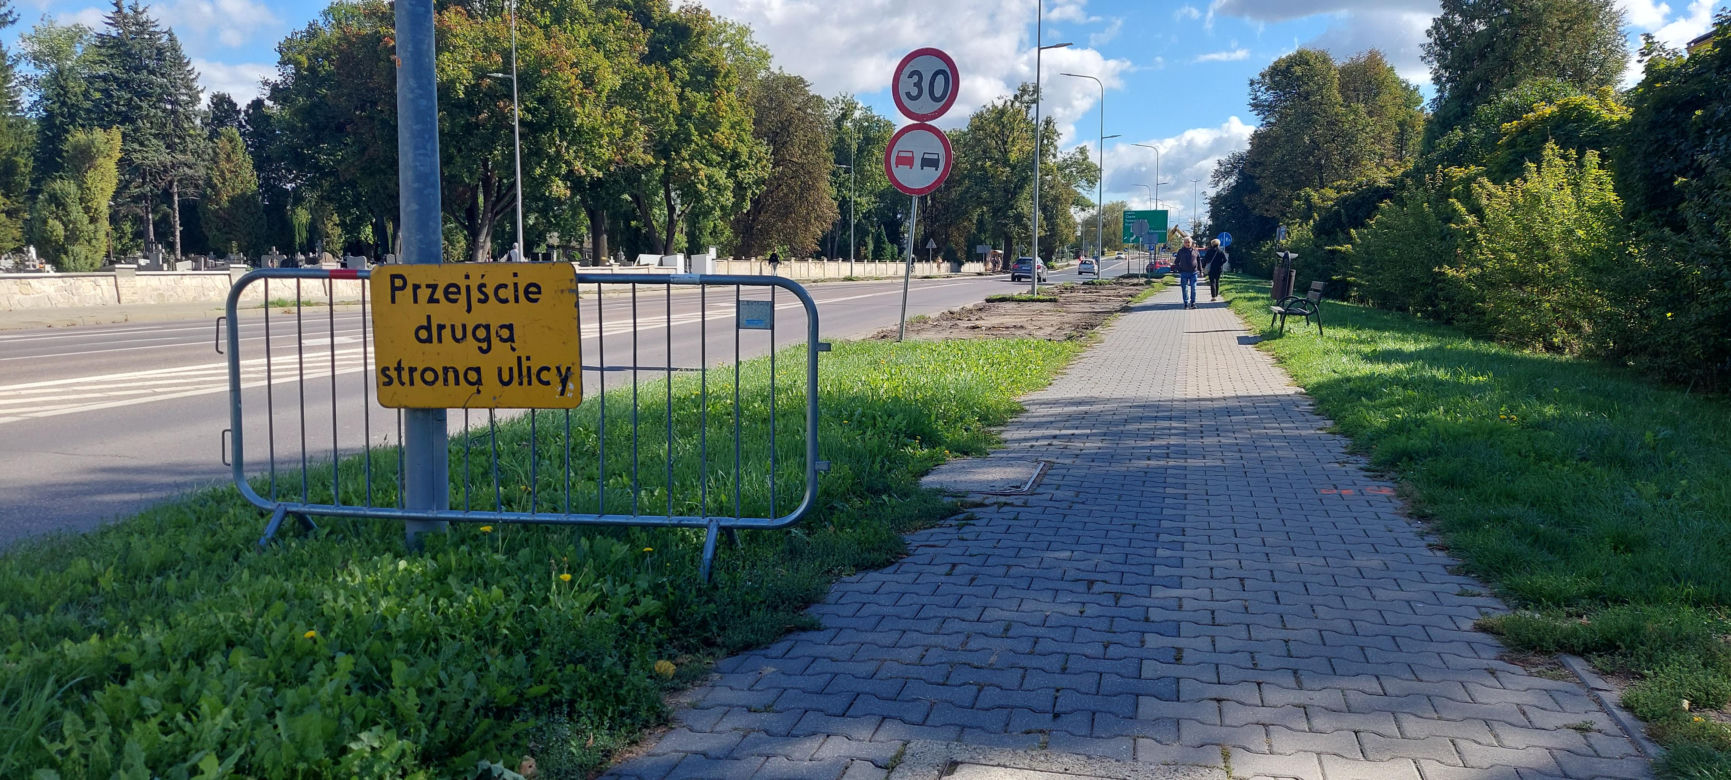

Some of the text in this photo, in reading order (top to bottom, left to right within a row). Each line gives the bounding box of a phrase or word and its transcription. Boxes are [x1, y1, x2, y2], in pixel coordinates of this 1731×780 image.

[905, 69, 950, 103] 30
[389, 272, 542, 314] Przejście
[414, 314, 516, 354] drugą
[380, 356, 572, 396] stroną ulicy
